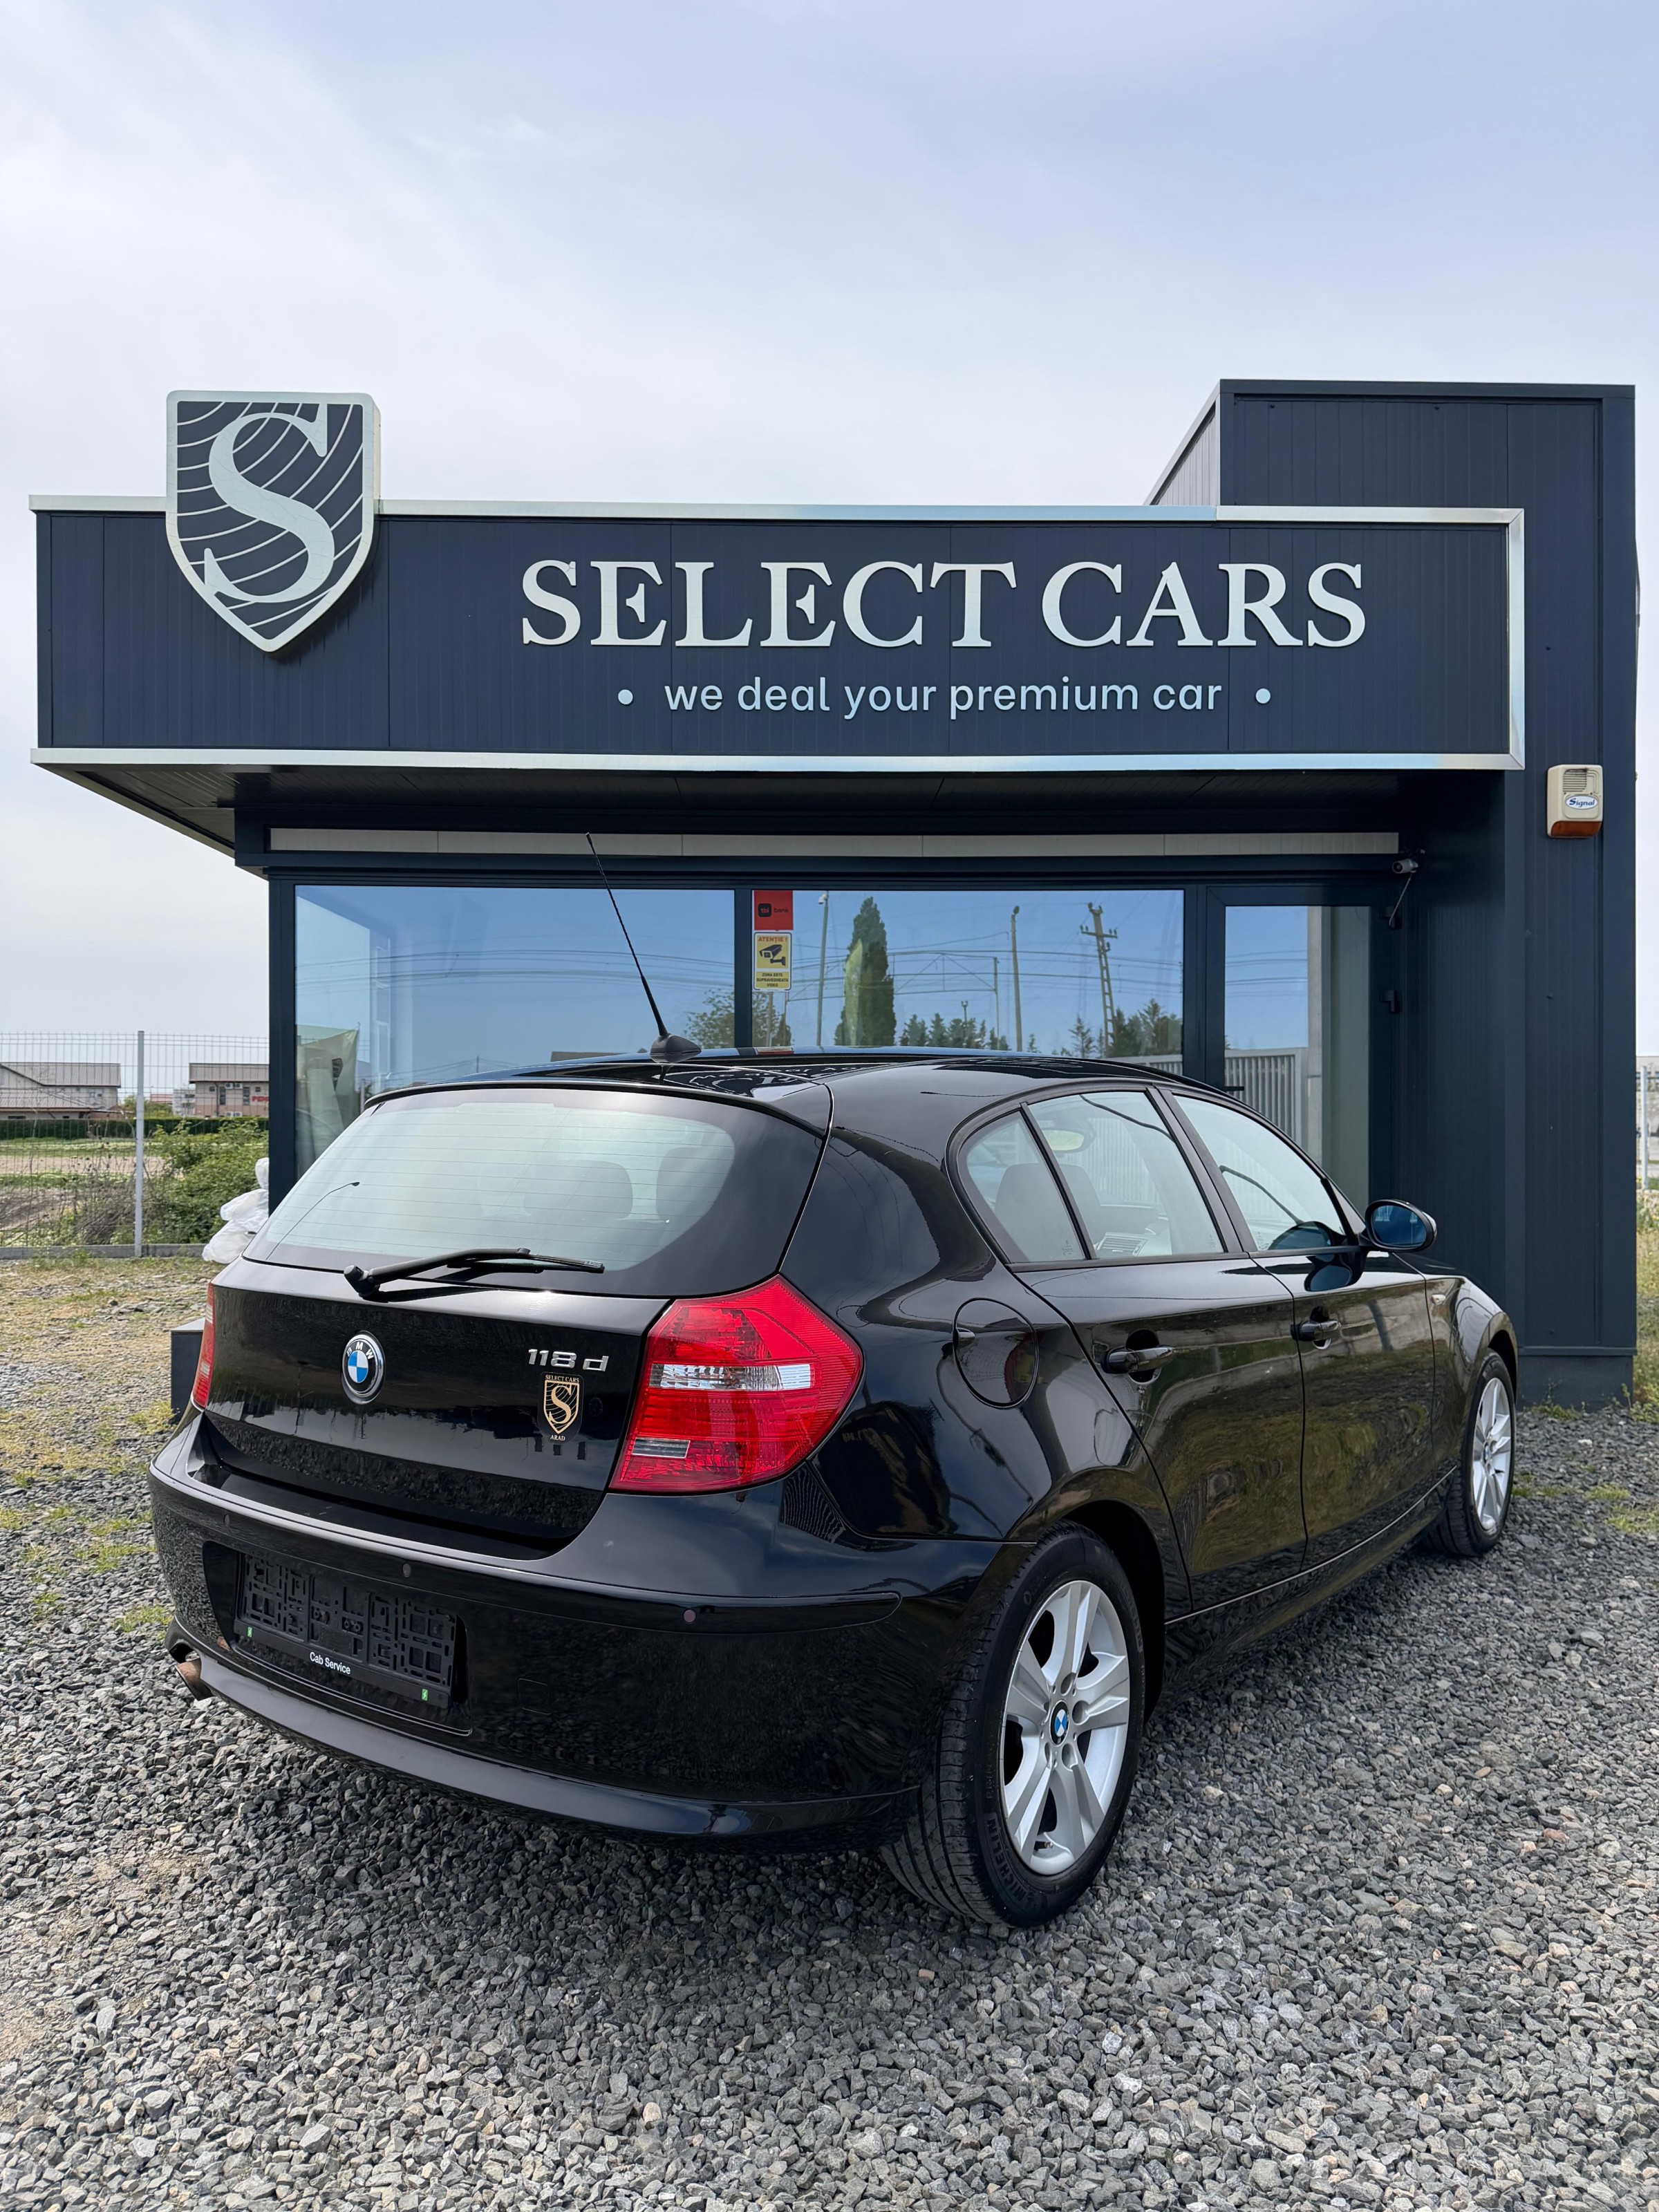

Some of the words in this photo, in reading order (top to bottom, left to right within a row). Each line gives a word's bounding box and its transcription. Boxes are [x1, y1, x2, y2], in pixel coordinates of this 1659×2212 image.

[521, 560, 1018, 648] SELECT
[1041, 561, 1367, 649] CARS
[665, 683, 723, 711] we
[738, 675, 831, 711] deal
[843, 683, 938, 720] your
[949, 675, 1139, 720] premium
[1152, 682, 1222, 711] car
[1569, 798, 1595, 807] Signal
[346, 1341, 375, 1360] BMW
[528, 1349, 577, 1368] 118
[310, 1651, 324, 1665] Cab
[325, 1657, 350, 1674] Service
[986, 1818, 1027, 1902] MICHELIN
